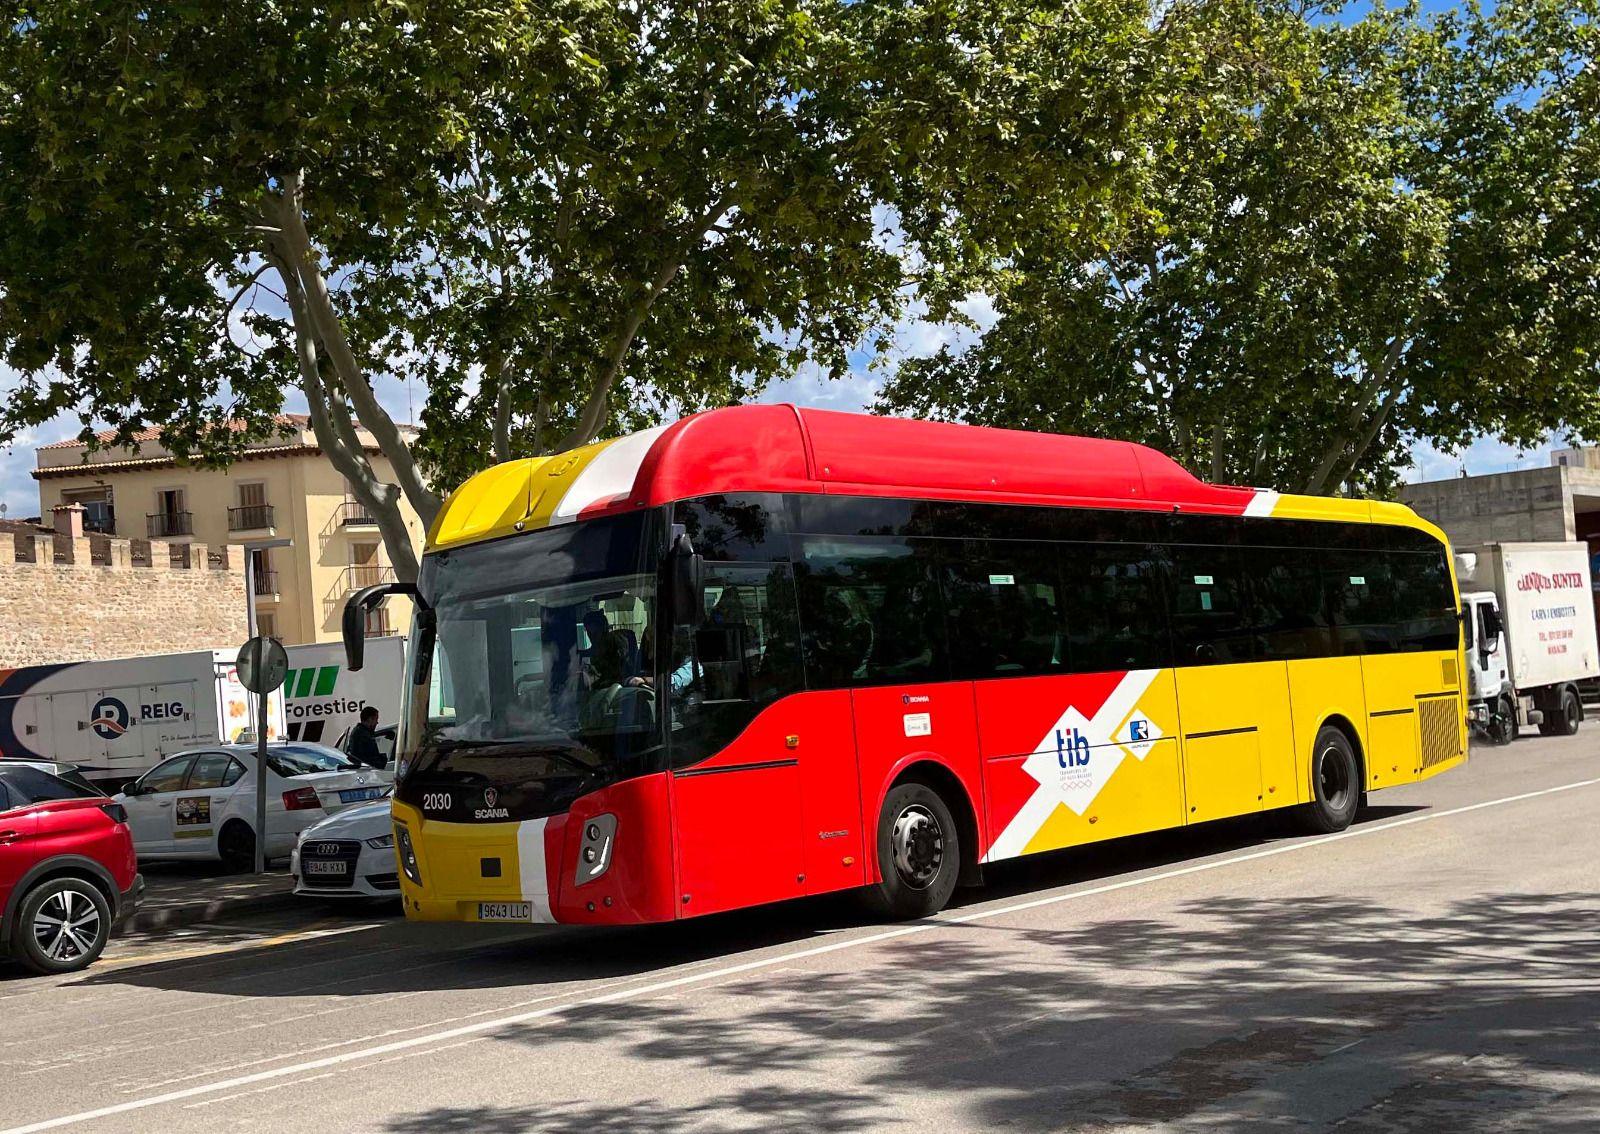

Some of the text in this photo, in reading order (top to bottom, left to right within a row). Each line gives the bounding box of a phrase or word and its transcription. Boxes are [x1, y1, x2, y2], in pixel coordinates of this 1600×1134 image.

[141, 702, 184, 719] REIG
[285, 698, 366, 718] Forestier
[423, 793, 451, 810] 2030
[475, 808, 509, 819] SCANIA
[484, 904, 529, 918] 9643 LLC
